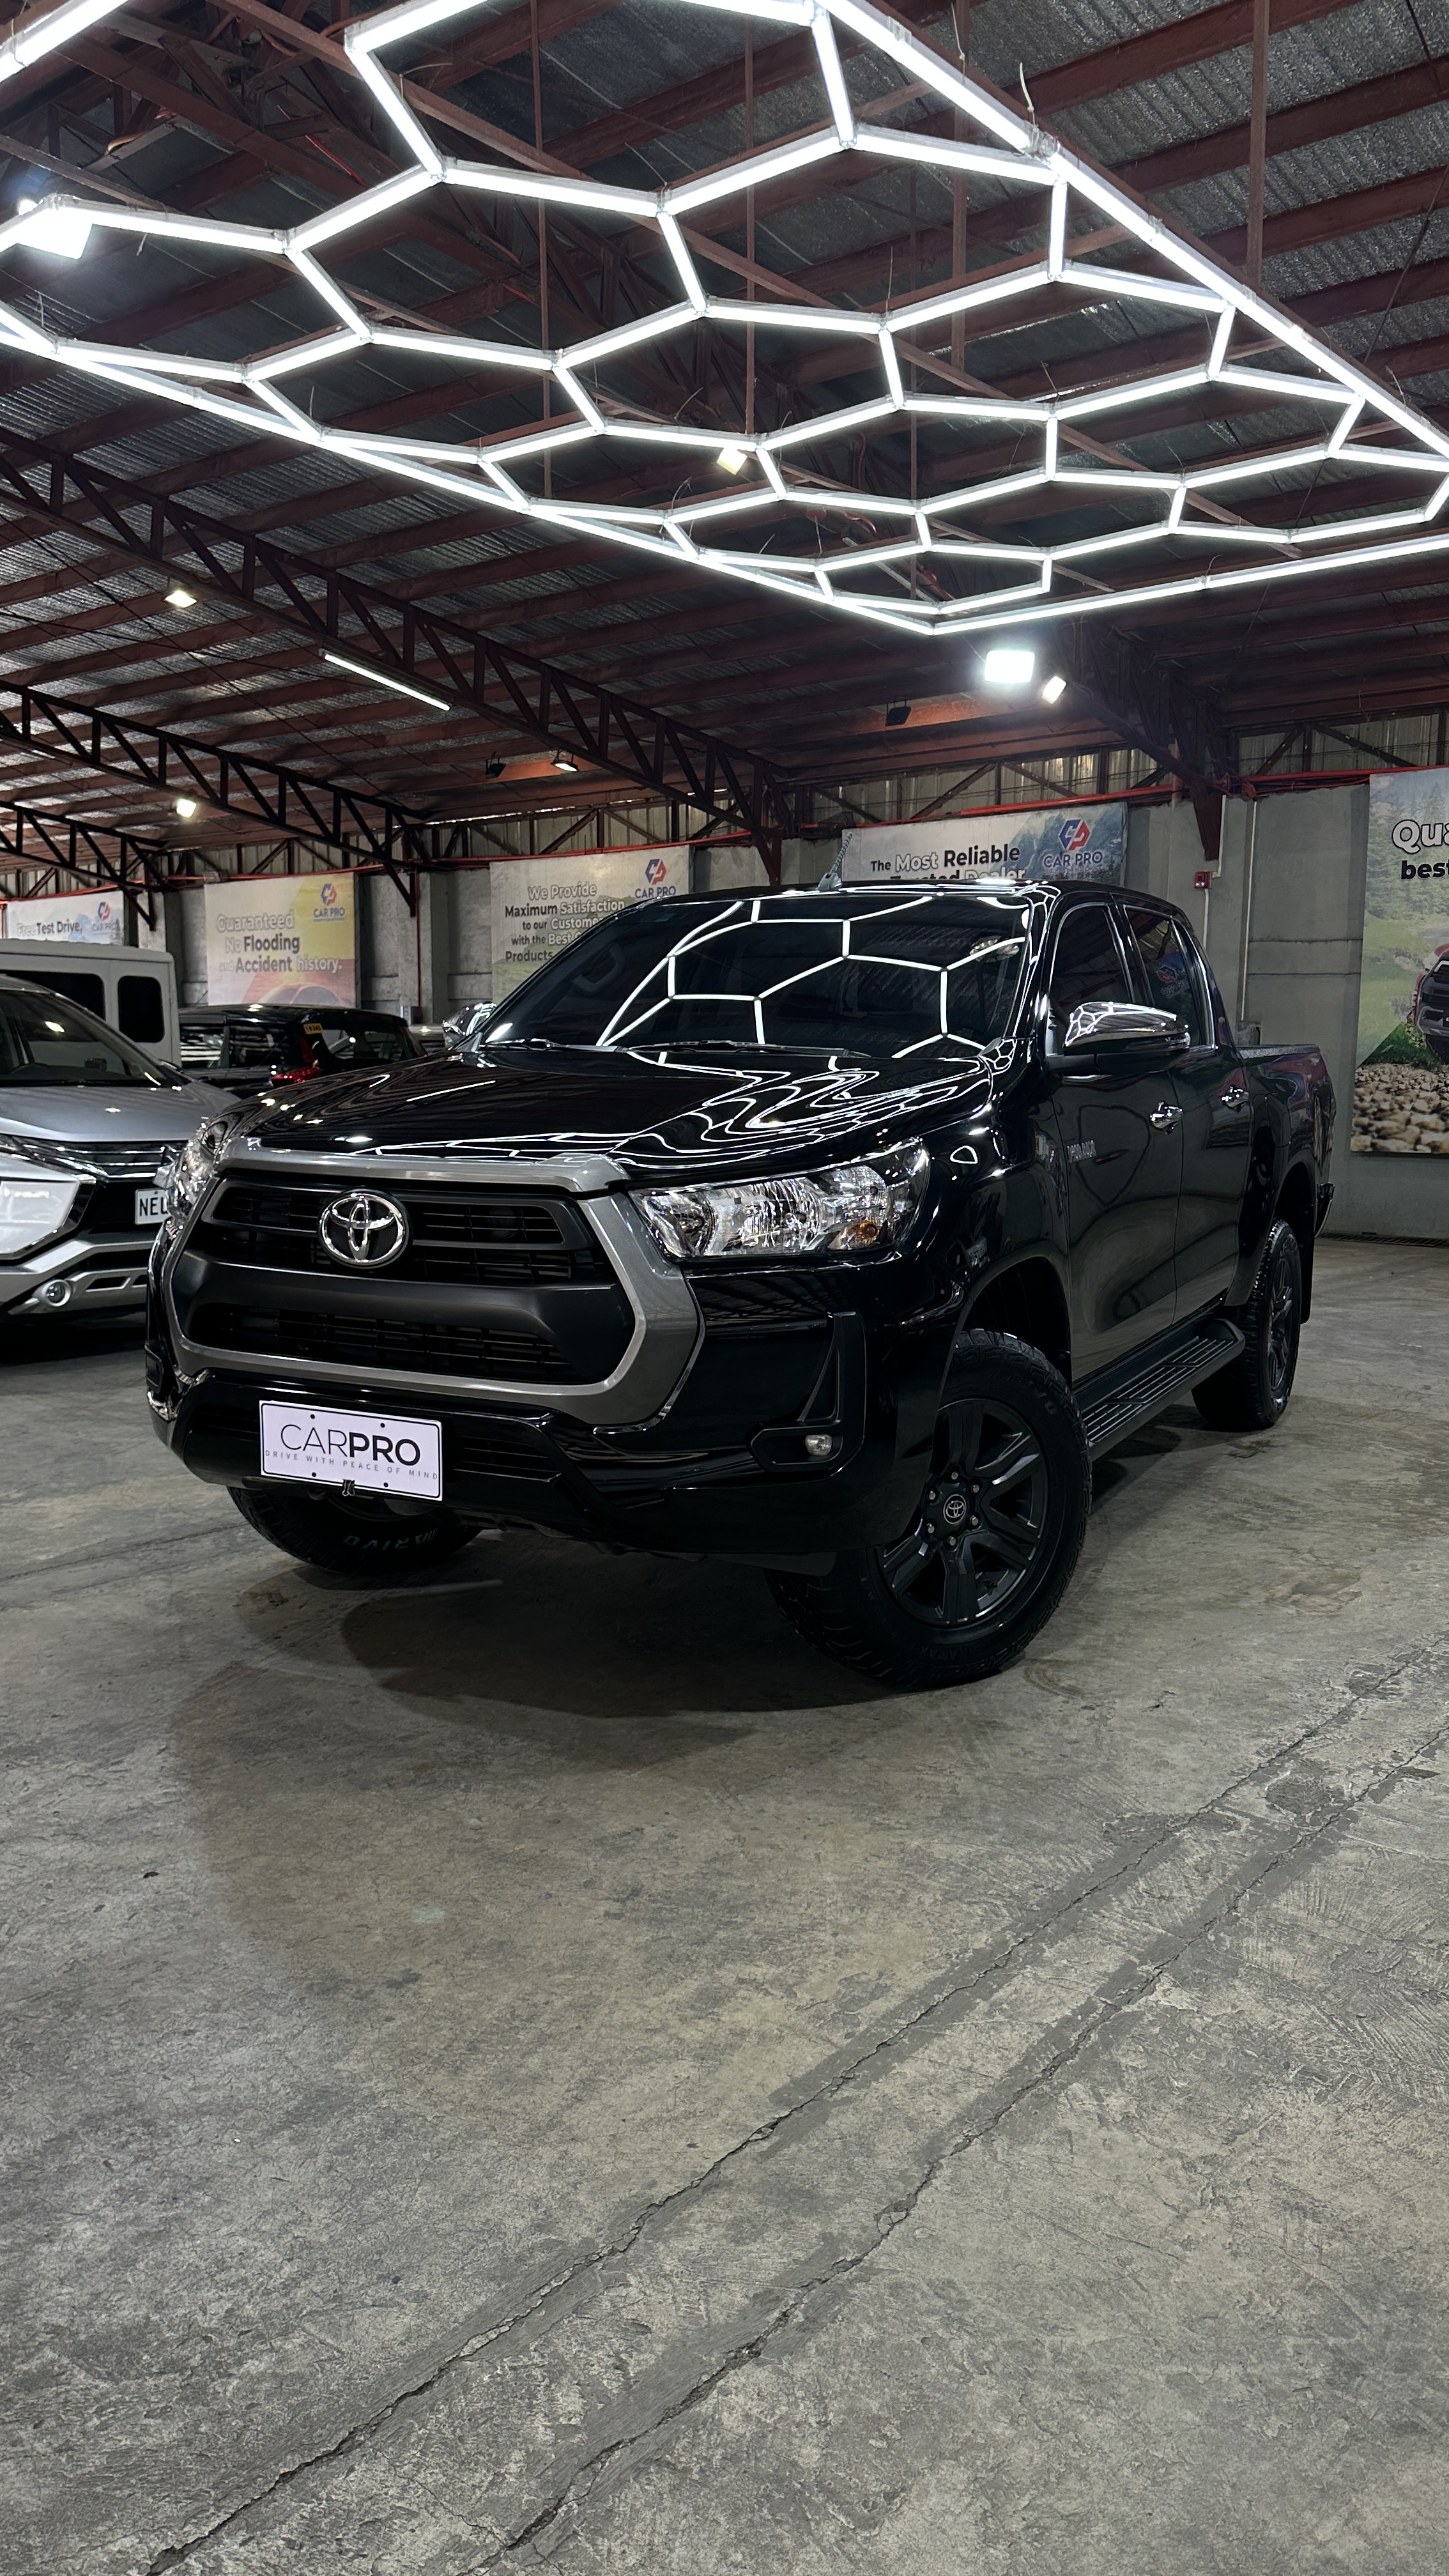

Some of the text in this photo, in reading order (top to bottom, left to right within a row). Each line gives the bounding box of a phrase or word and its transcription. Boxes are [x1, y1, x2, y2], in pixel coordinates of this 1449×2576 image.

[871, 844, 1020, 873] The Most Reliable
[1043, 851, 1103, 868] CAR PRO
[1401, 859, 1449, 879] bes
[527, 881, 597, 901] We Provide
[634, 885, 677, 899] CAR PRO
[313, 907, 345, 918] CAR PRO
[505, 898, 625, 917] Maximum Satisfaction
[37, 923, 55, 935] Test
[57, 919, 82, 933] Drive,
[217, 909, 295, 933] Guaranteed
[523, 921, 531, 930] to
[551, 916, 604, 930] Custome
[225, 933, 300, 954] No Flooding
[512, 935, 530, 946] with
[532, 935, 546, 944] the
[548, 933, 572, 946] Best
[236, 955, 292, 973] Accident
[296, 954, 343, 974] history.
[506, 950, 553, 962] Products
[281, 1424, 420, 1466] CARPRO
[265, 1450, 438, 1480] DRIVE WITH PEACE OF MIND
